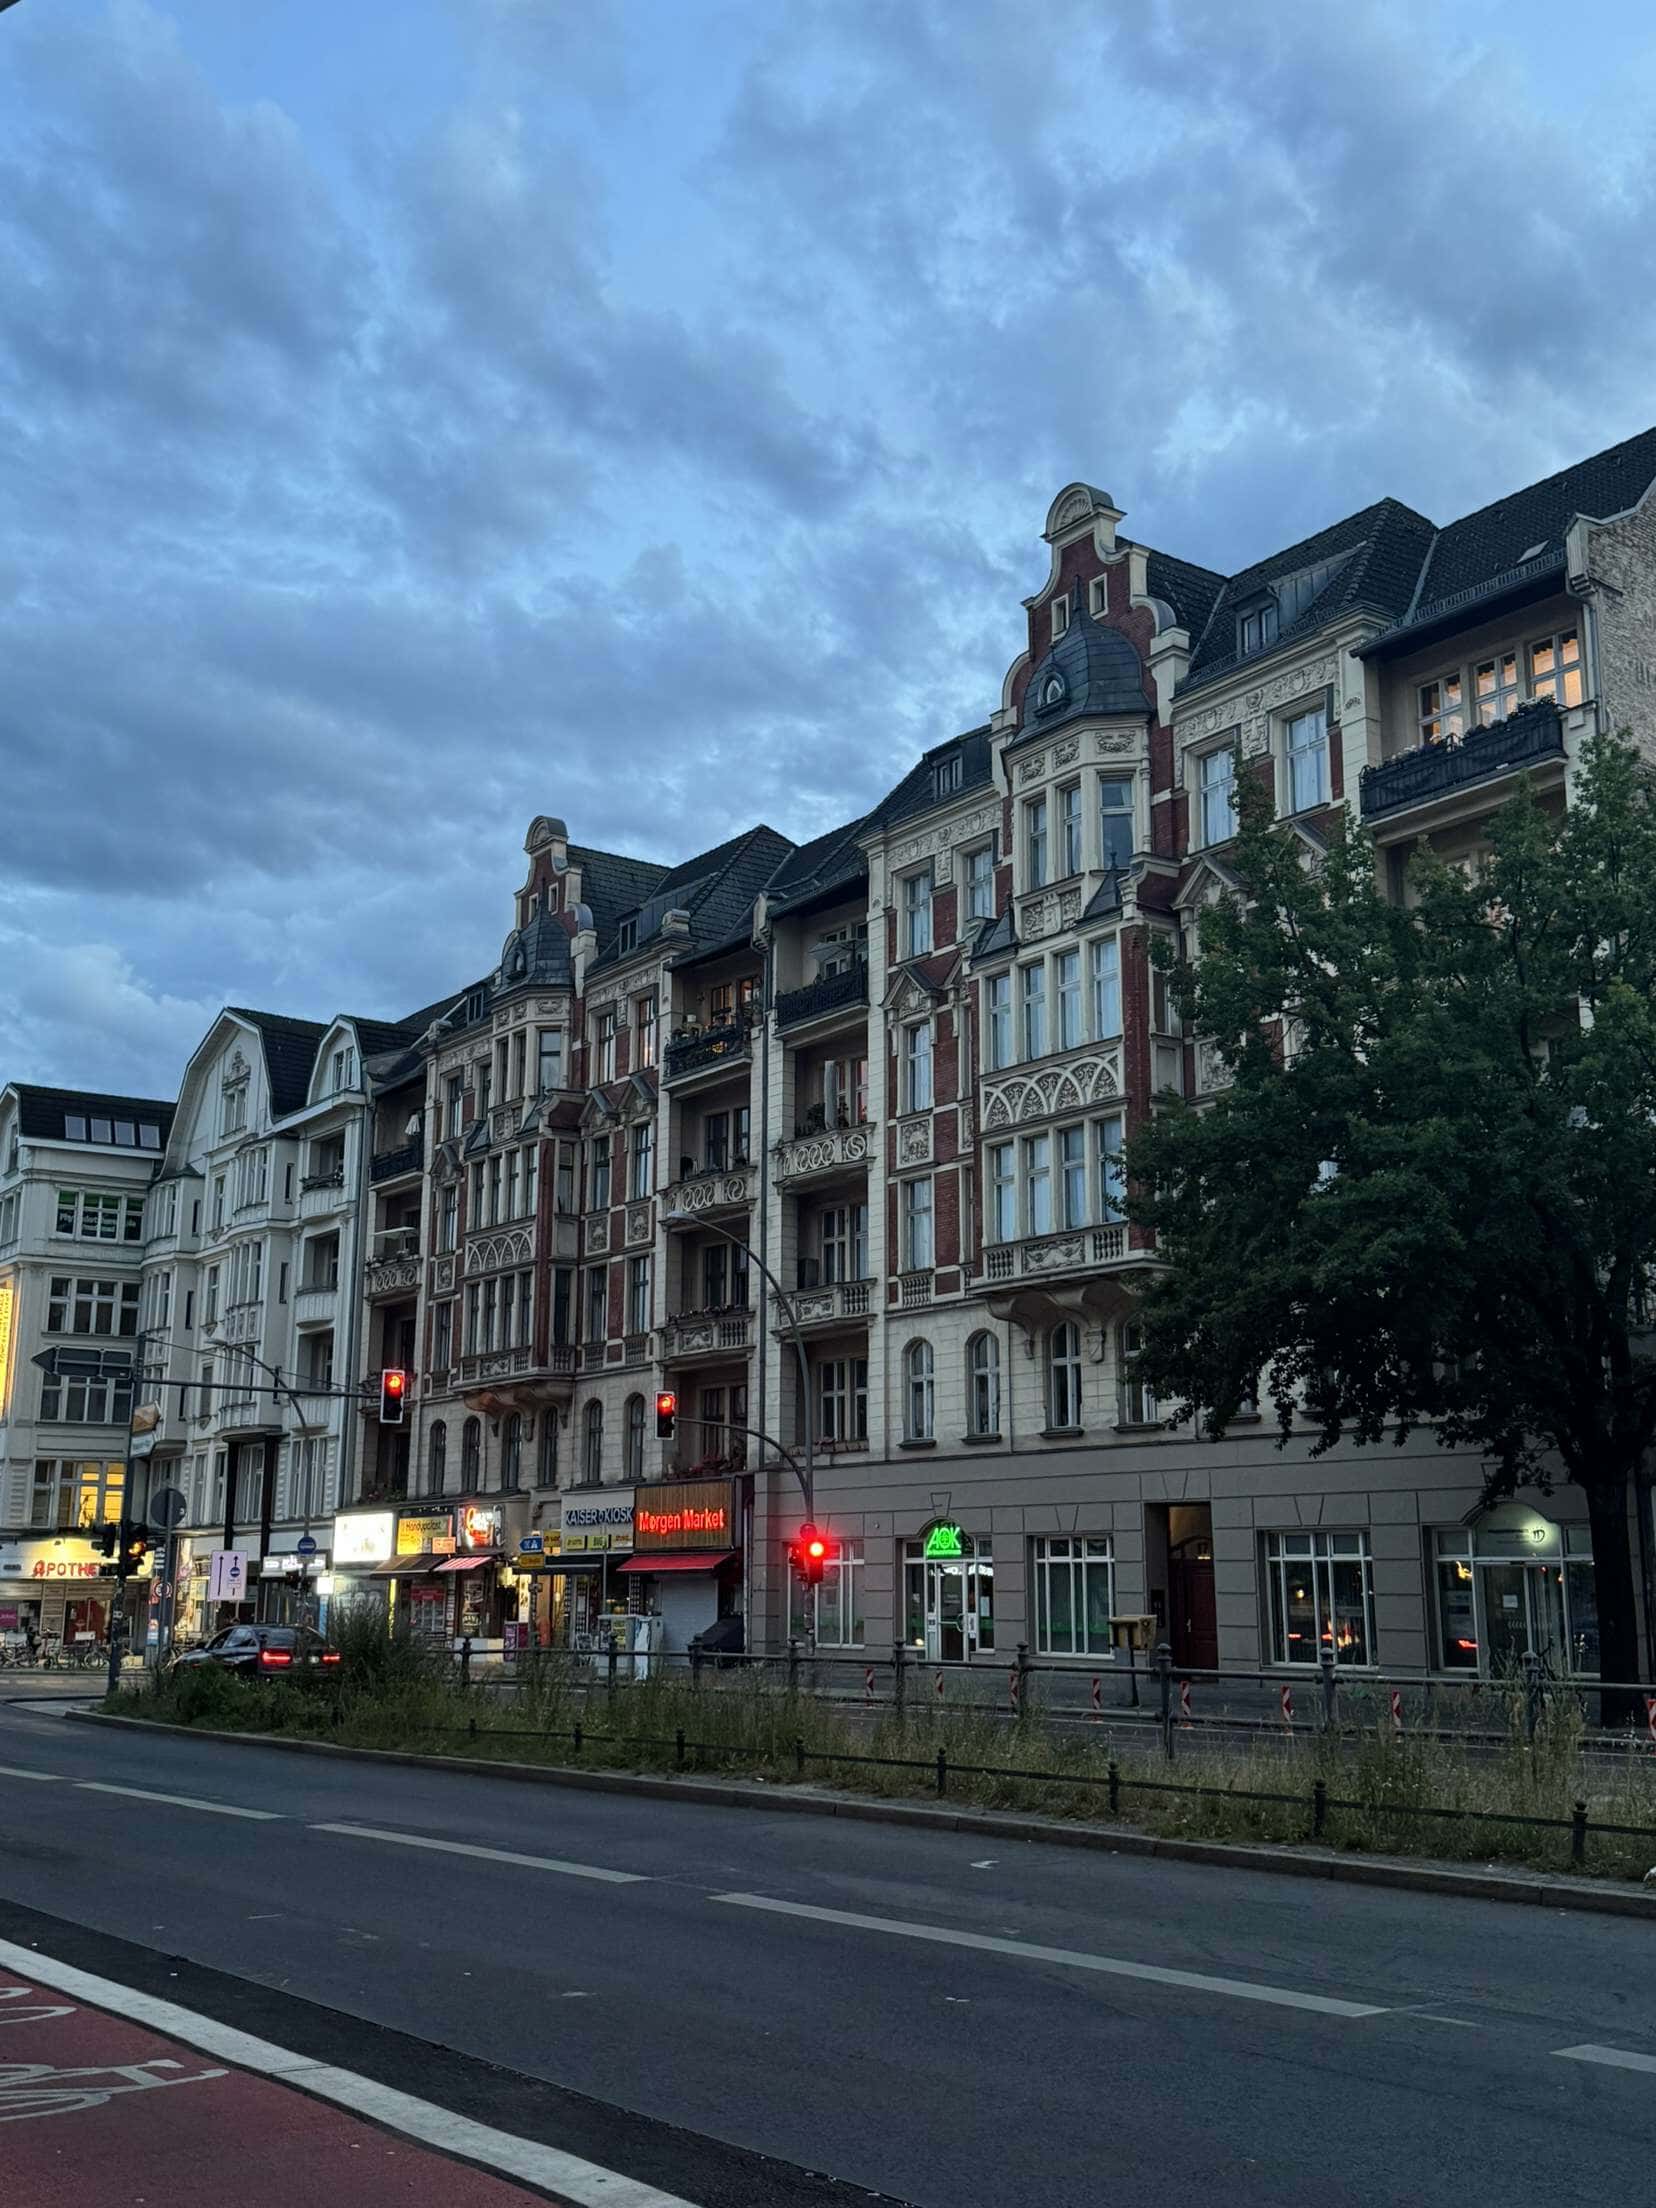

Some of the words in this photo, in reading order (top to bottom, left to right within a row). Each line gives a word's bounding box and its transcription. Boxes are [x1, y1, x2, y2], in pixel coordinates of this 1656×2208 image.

[566, 1509, 598, 1525] KAISER
[604, 1507, 633, 1524] KIOSK
[640, 1511, 680, 1534] Morgen
[684, 1507, 724, 1530] Market
[927, 1527, 961, 1549] AOK
[32, 1559, 102, 1577] APOTHE
